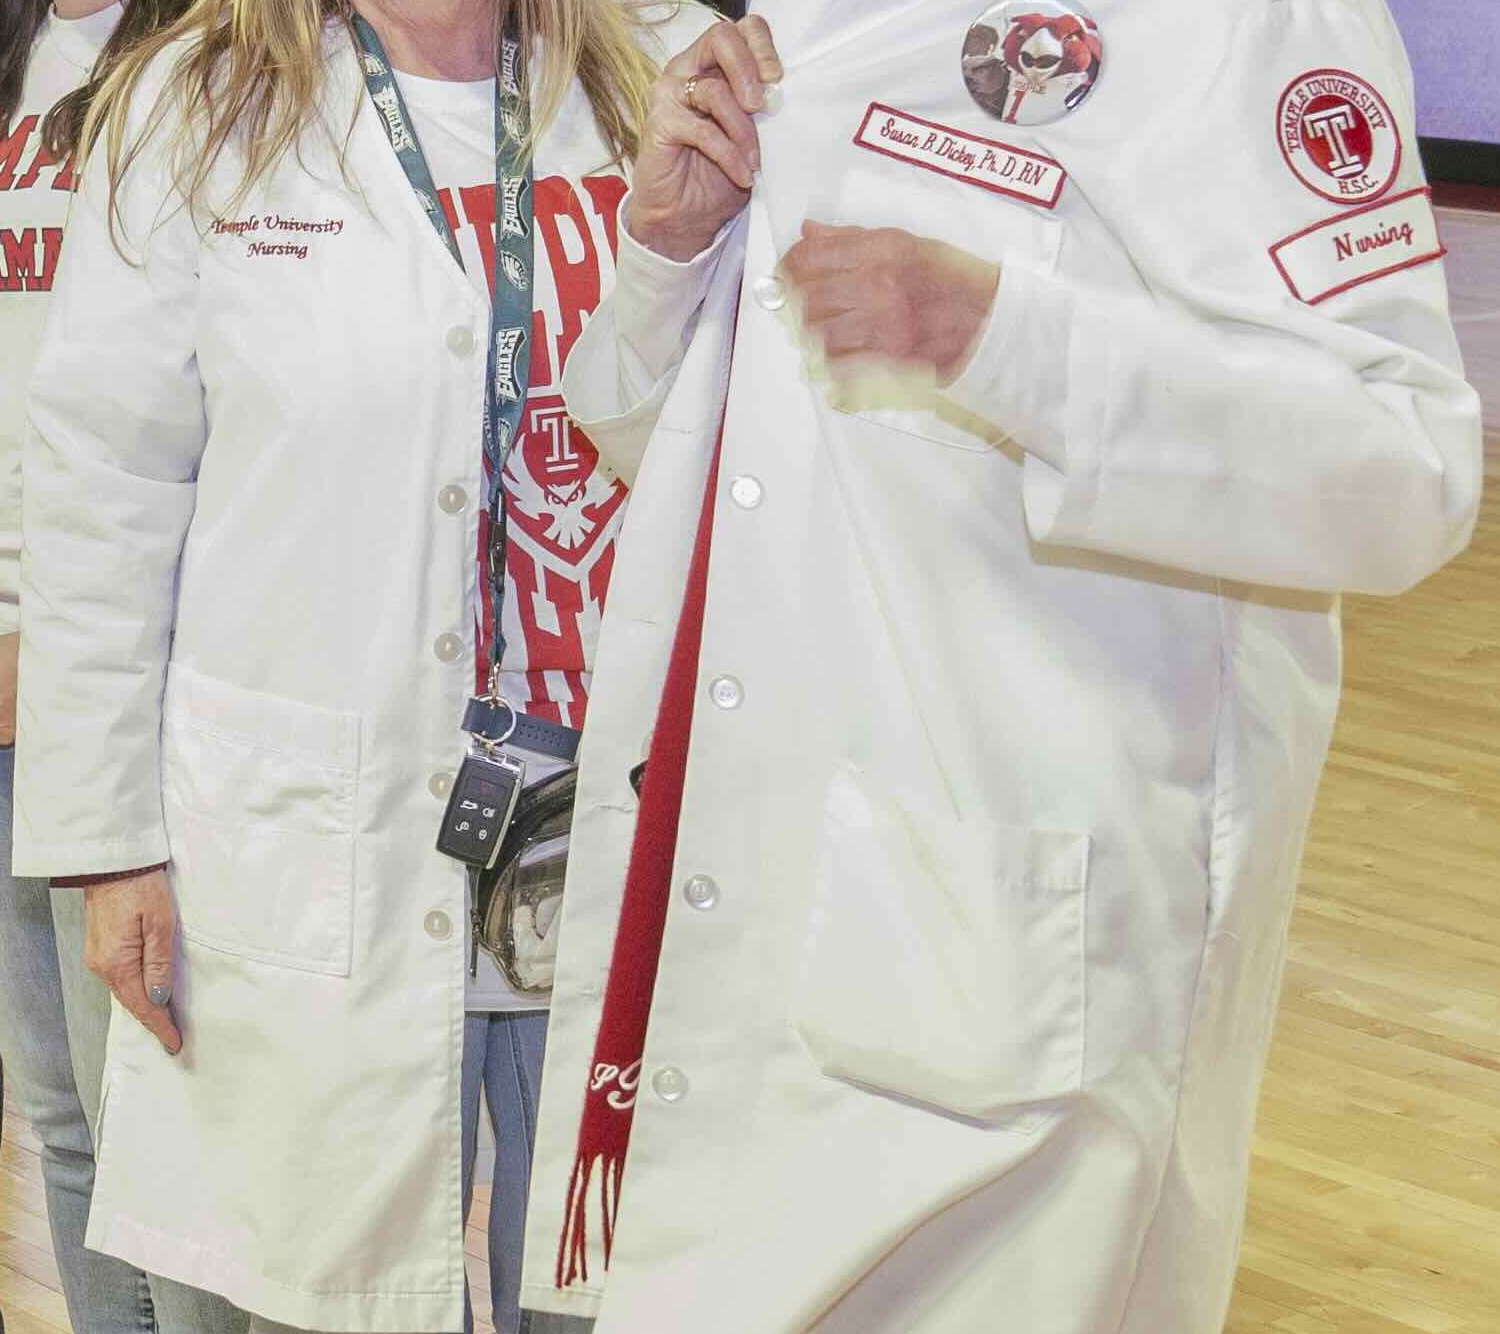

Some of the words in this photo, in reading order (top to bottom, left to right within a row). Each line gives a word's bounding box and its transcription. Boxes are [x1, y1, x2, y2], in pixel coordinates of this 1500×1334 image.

[1284, 90, 1310, 154] TEMPLE
[1306, 77, 1387, 131] UNIVERSITY
[880, 117, 919, 149] Susan
[920, 132, 935, 153] B.
[935, 137, 976, 171] Dickey,
[1017, 161, 1048, 186] RN
[211, 214, 259, 237] Temple
[263, 214, 344, 235] University
[500, 175, 530, 239] EAGLES
[248, 241, 308, 259] Nursing
[1333, 222, 1414, 262] Nursing
[495, 327, 528, 407] EAGLES
